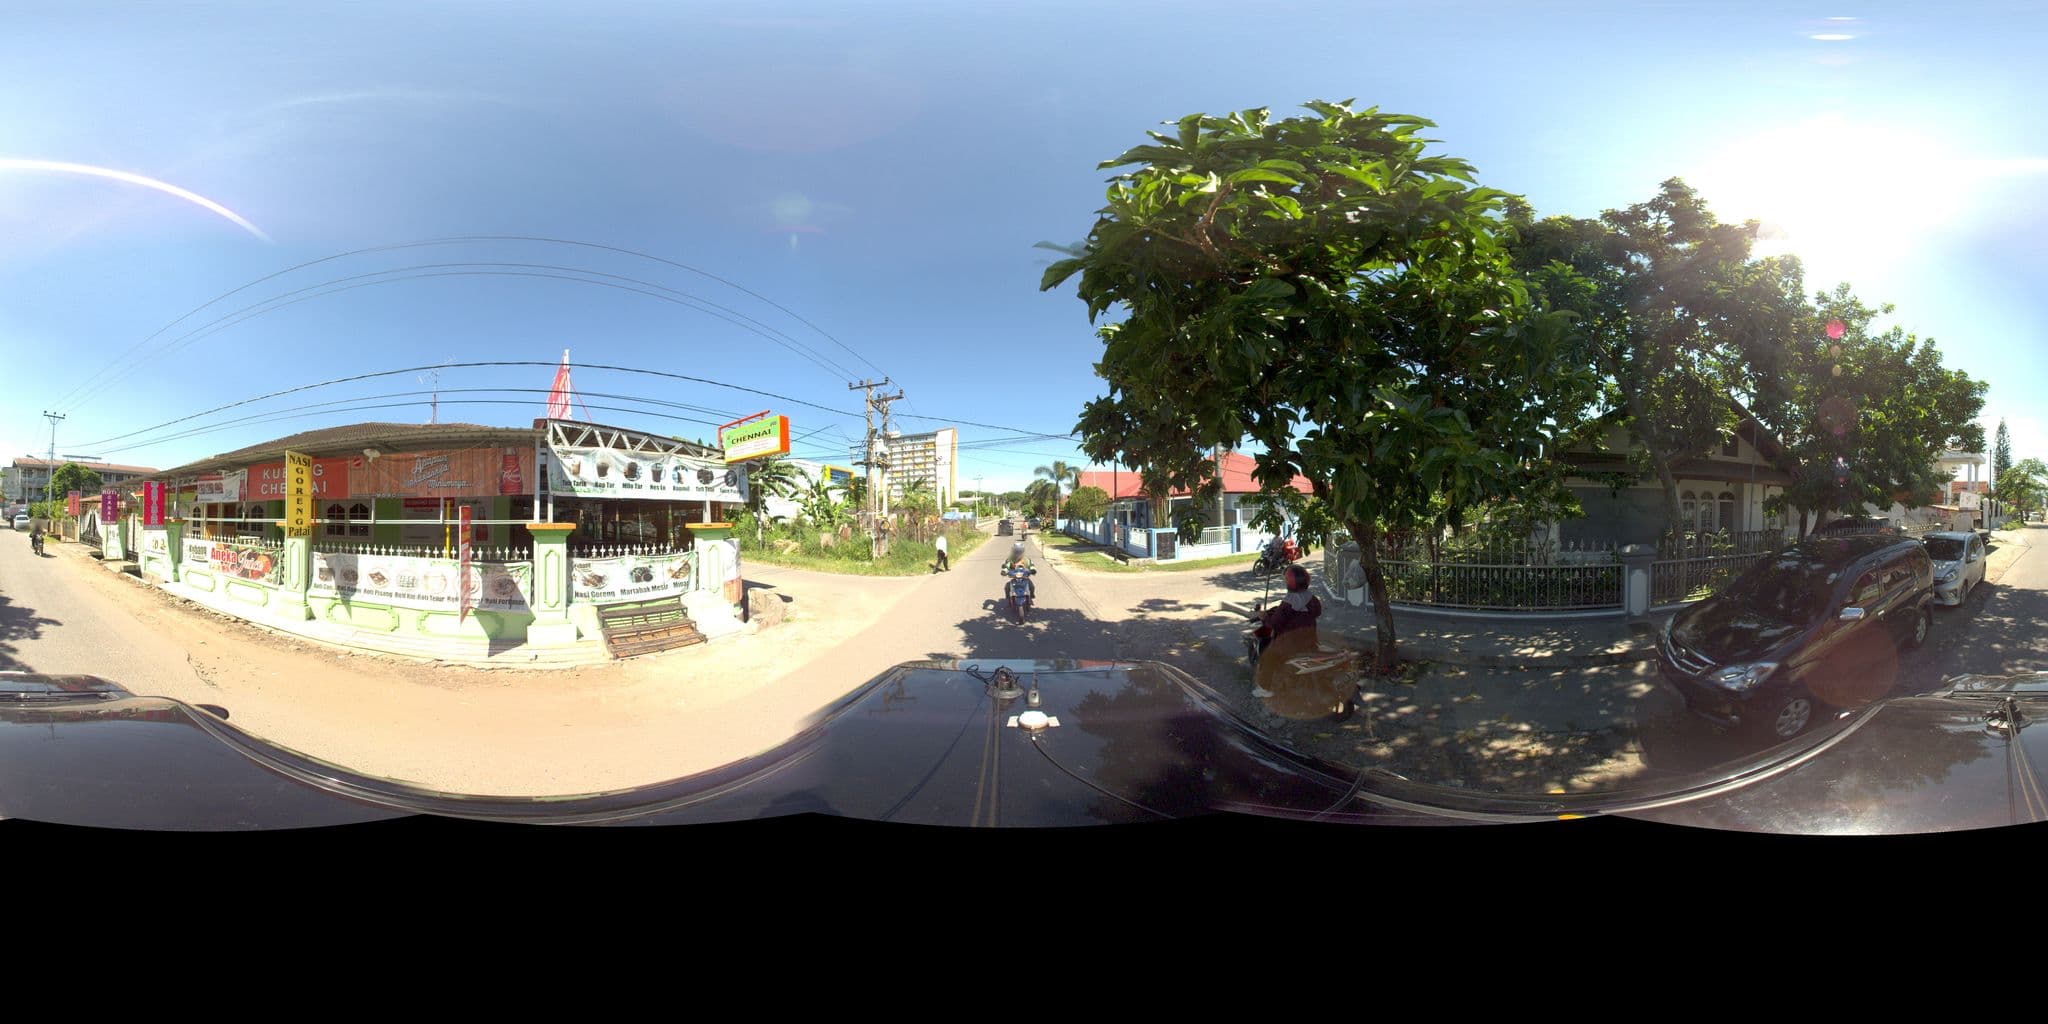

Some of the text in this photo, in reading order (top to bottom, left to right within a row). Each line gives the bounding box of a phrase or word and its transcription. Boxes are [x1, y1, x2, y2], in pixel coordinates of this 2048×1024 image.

[731, 428, 771, 445] CHENNAI
[288, 455, 311, 467] NASI
[263, 463, 323, 480] KUBG
[261, 483, 327, 495] CHEAI
[295, 467, 304, 526] GORENG
[211, 547, 237, 564] Aneka
[575, 590, 589, 598] Nasi
[620, 586, 650, 596] Martabak
